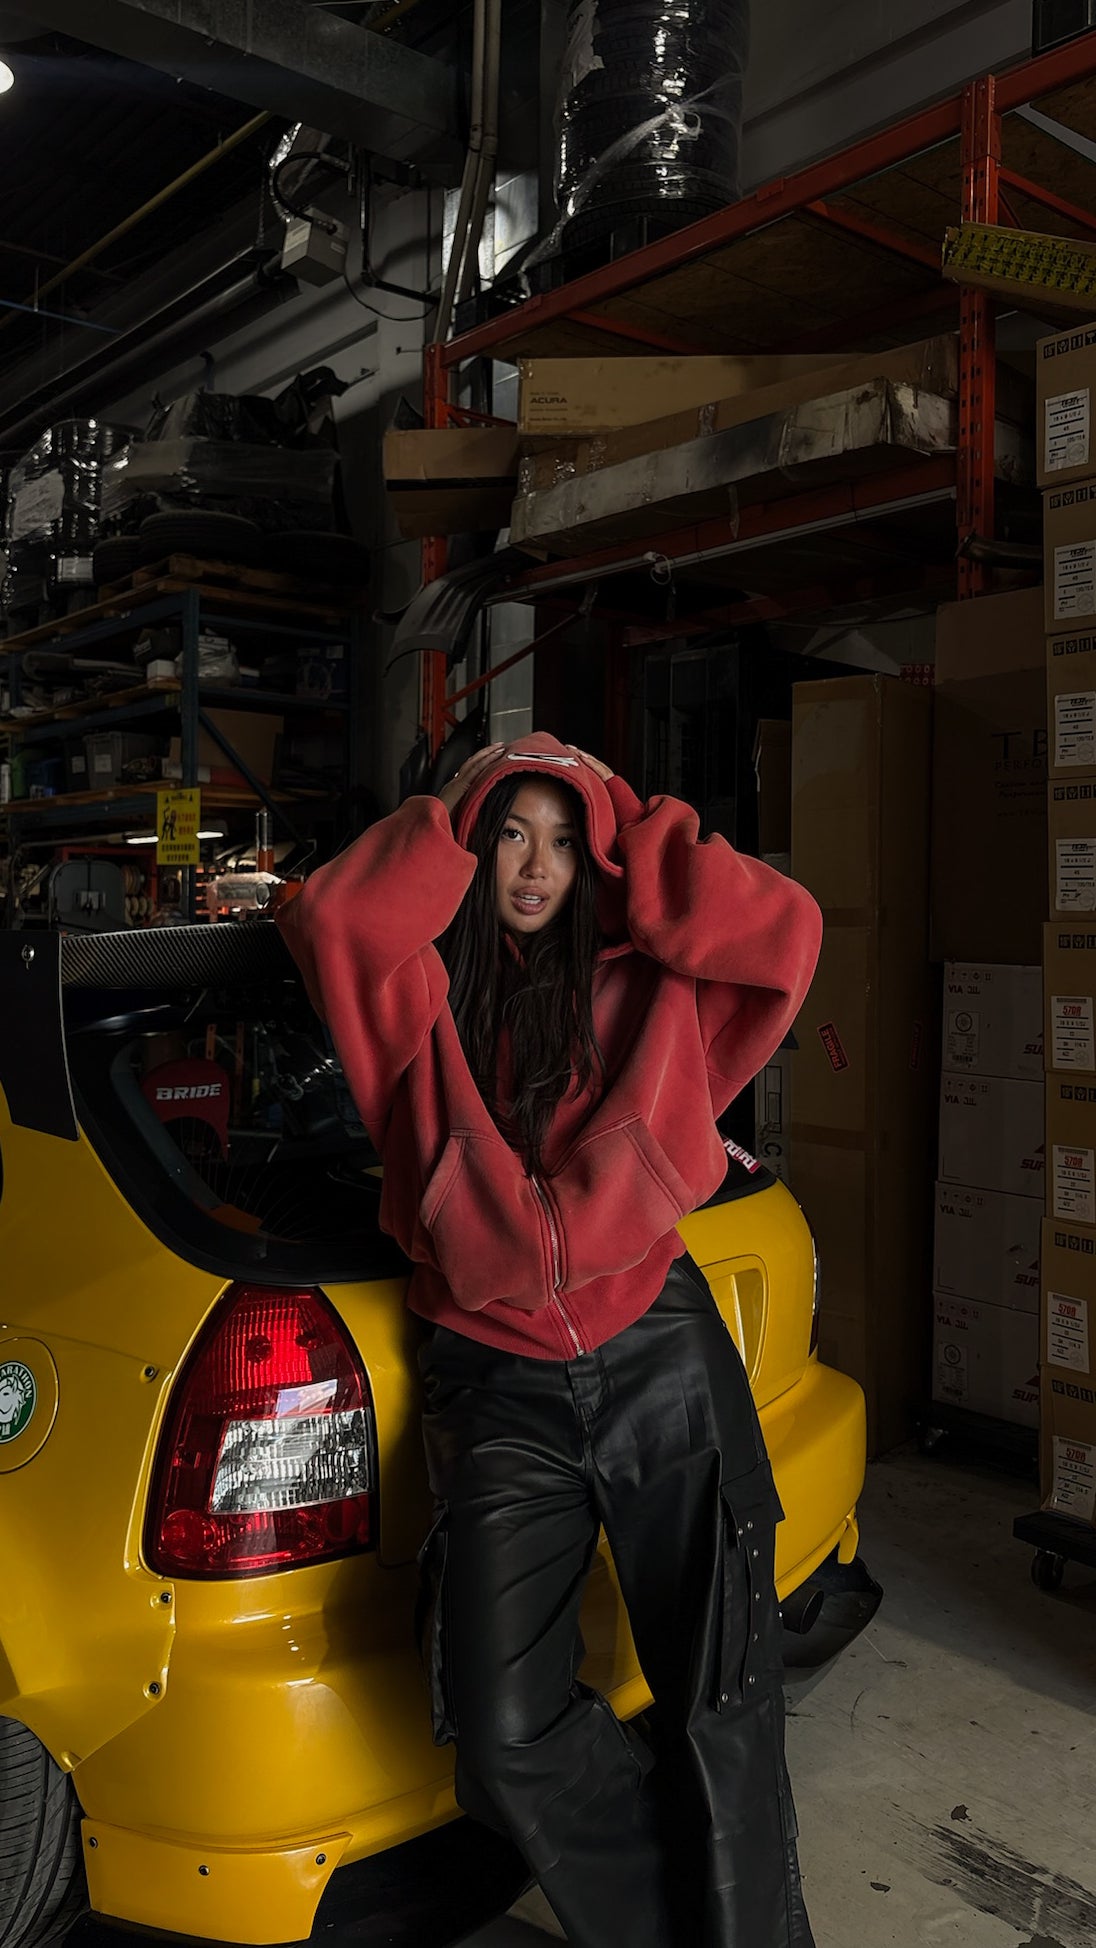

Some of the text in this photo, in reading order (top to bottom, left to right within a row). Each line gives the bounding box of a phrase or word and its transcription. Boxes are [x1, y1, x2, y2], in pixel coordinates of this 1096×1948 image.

[948, 985, 963, 994] VIA
[156, 1083, 222, 1100] BRIDE
[944, 1095, 959, 1104] VIA
[940, 1204, 955, 1215] VIA
[936, 1314, 951, 1326] VIA
[0, 1365, 33, 1399] ARATHON
